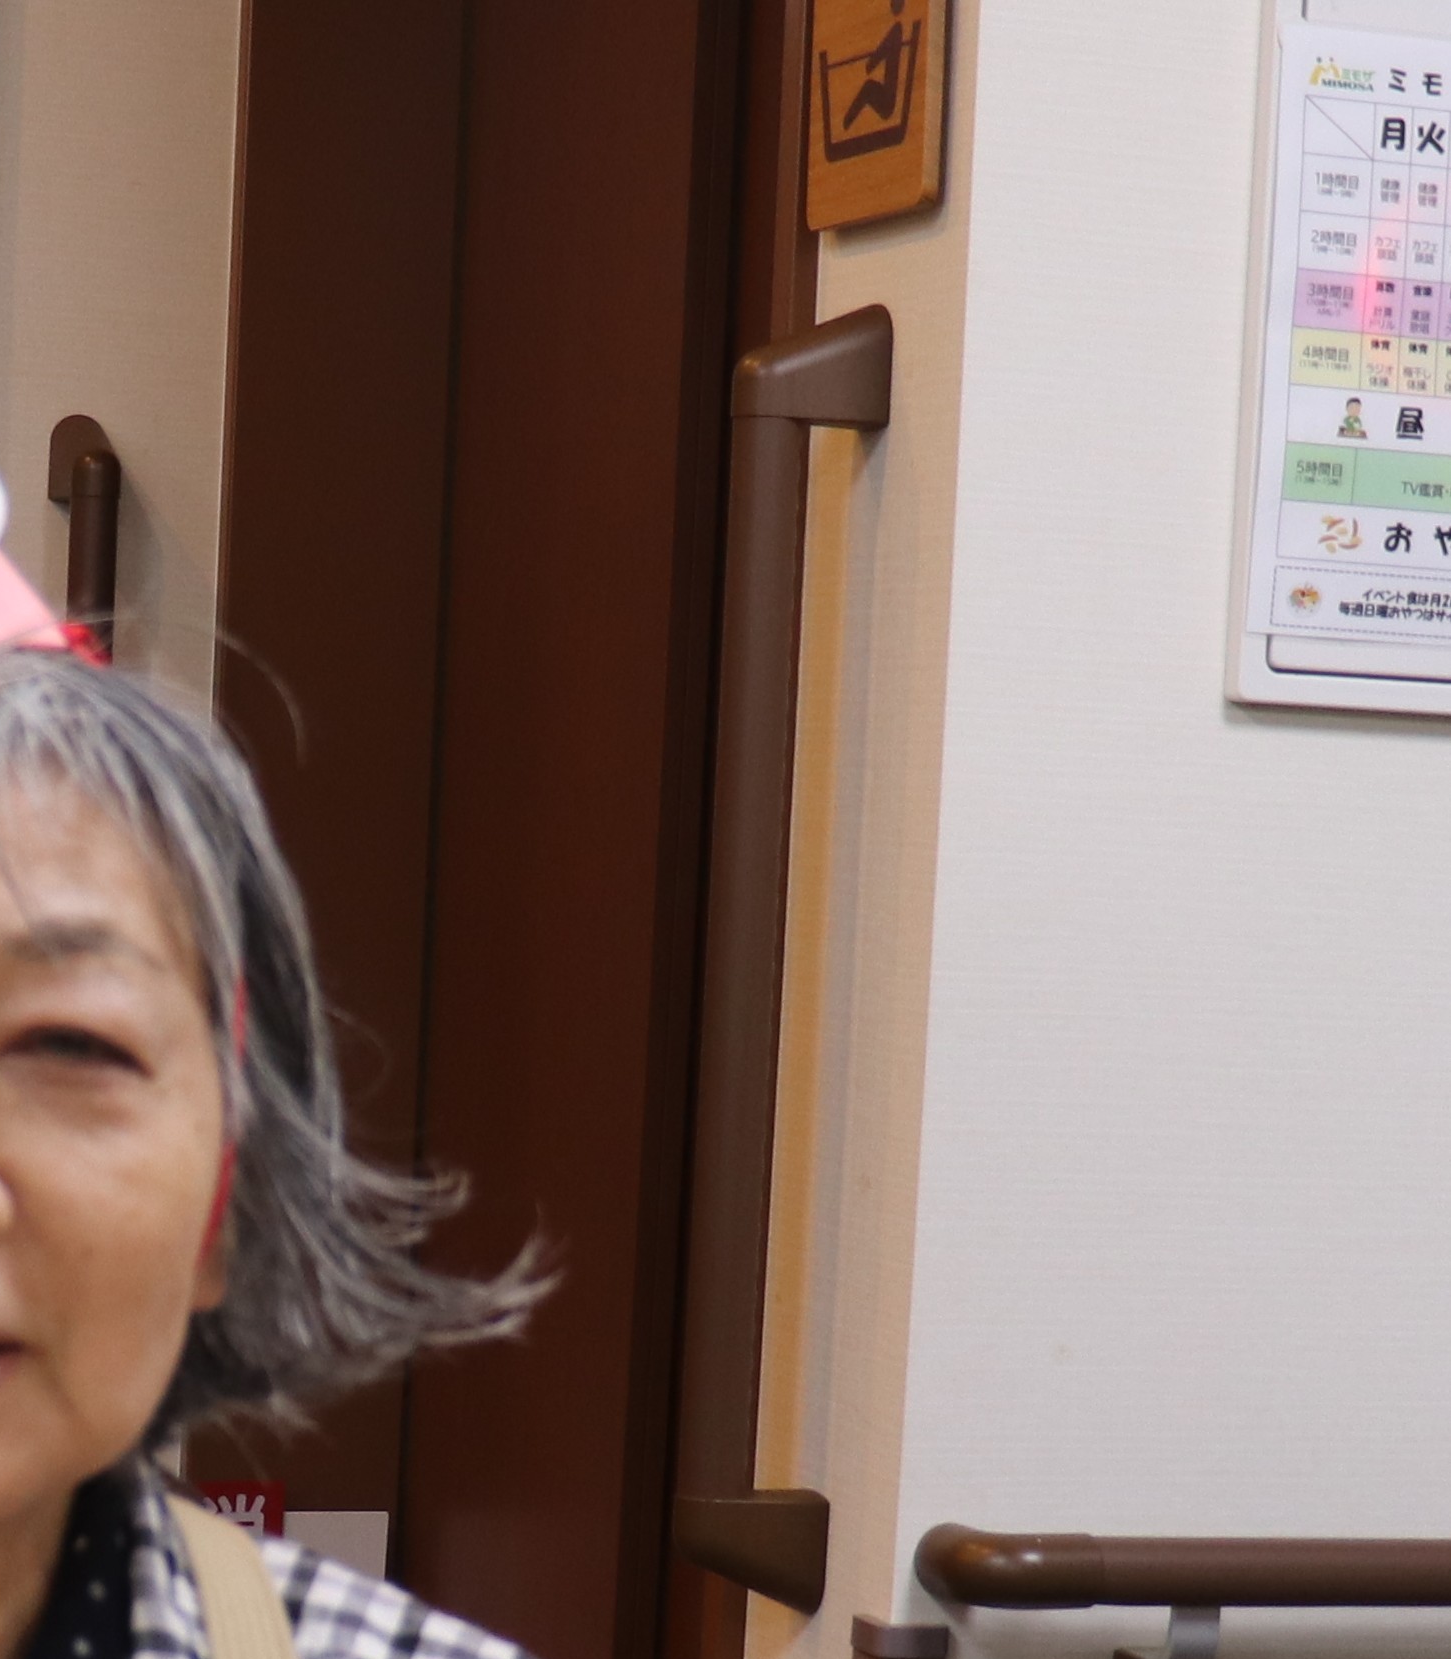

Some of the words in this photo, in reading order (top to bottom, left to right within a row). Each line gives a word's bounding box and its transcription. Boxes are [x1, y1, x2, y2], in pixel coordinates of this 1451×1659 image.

[1321, 79, 1374, 92] MIMOSA
[1381, 117, 1406, 151] 月
[1416, 121, 1446, 154] 火
[1396, 406, 1424, 440] 昼
